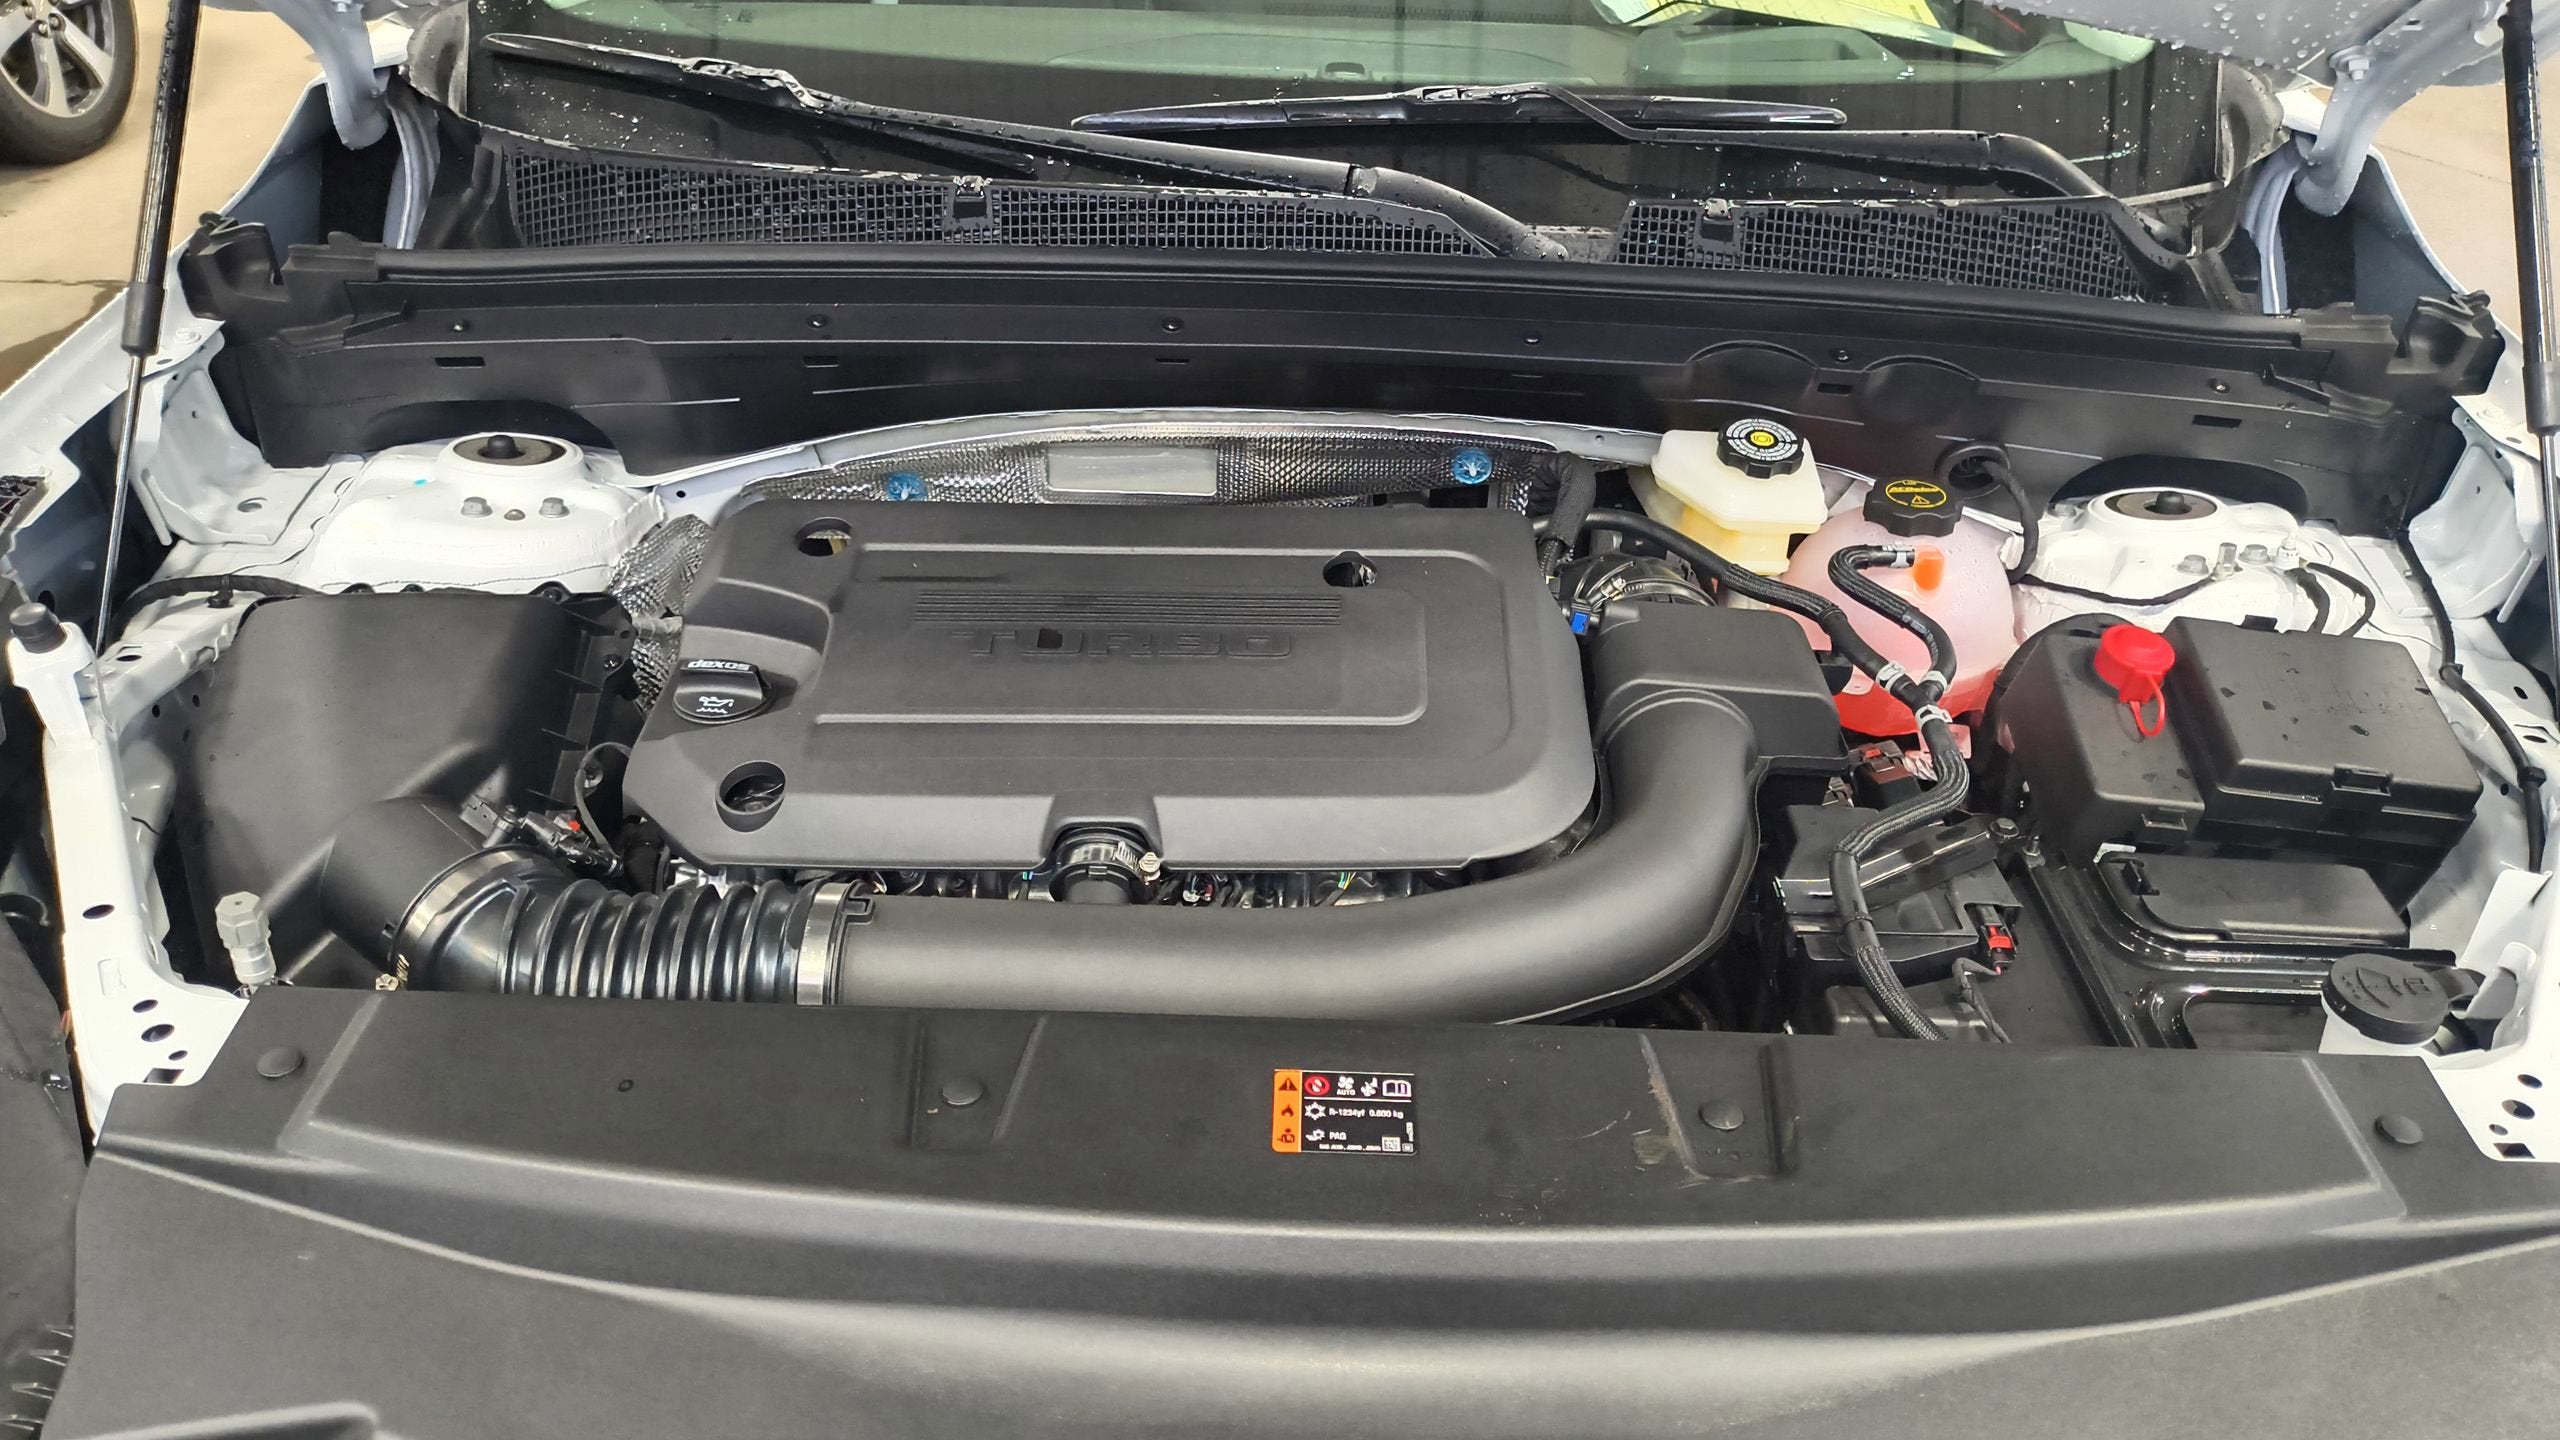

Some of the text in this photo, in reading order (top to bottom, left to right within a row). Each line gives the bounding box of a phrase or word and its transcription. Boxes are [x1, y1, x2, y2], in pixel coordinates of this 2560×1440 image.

[951, 630, 1291, 658] TURBO
[687, 659, 751, 671] dexos
[1329, 1132, 1347, 1140] PAG
